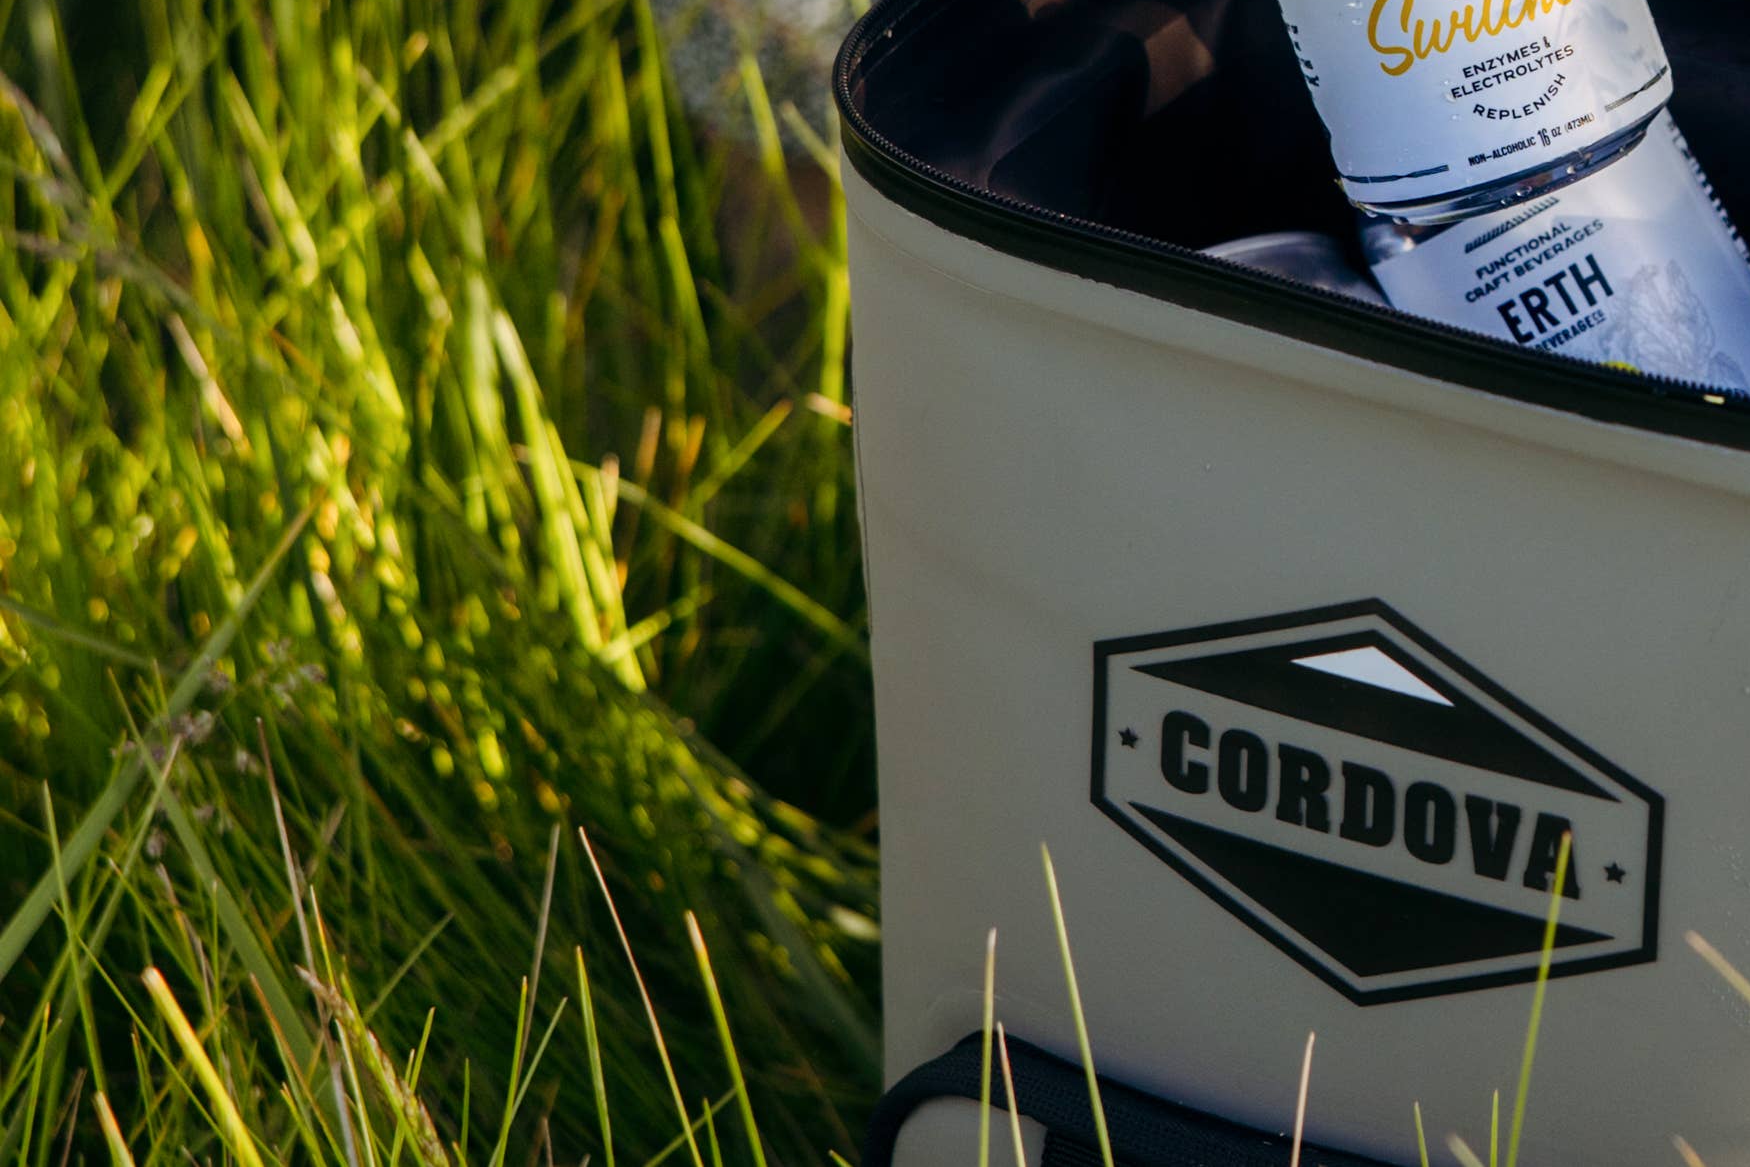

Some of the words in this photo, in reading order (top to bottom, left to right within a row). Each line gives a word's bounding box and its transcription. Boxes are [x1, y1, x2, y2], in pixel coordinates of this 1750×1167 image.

[1451, 45, 1574, 99] ELECTROLYTES
[1462, 41, 1541, 79] ENZYMES
[1543, 36, 1552, 49] &
[1473, 74, 1566, 120] REPLENISH
[1468, 137, 1537, 167] NON-ALCOHOLIC
[1537, 127, 1551, 146] 16
[1551, 127, 1562, 138] OZ
[1465, 271, 1510, 303] CRAFT
[1513, 219, 1603, 277] BEVERAGES
[1476, 222, 1571, 280] FUNCTIONAL
[1497, 253, 1614, 344] ERTH
[1160, 709, 1581, 901] CORDOVA
